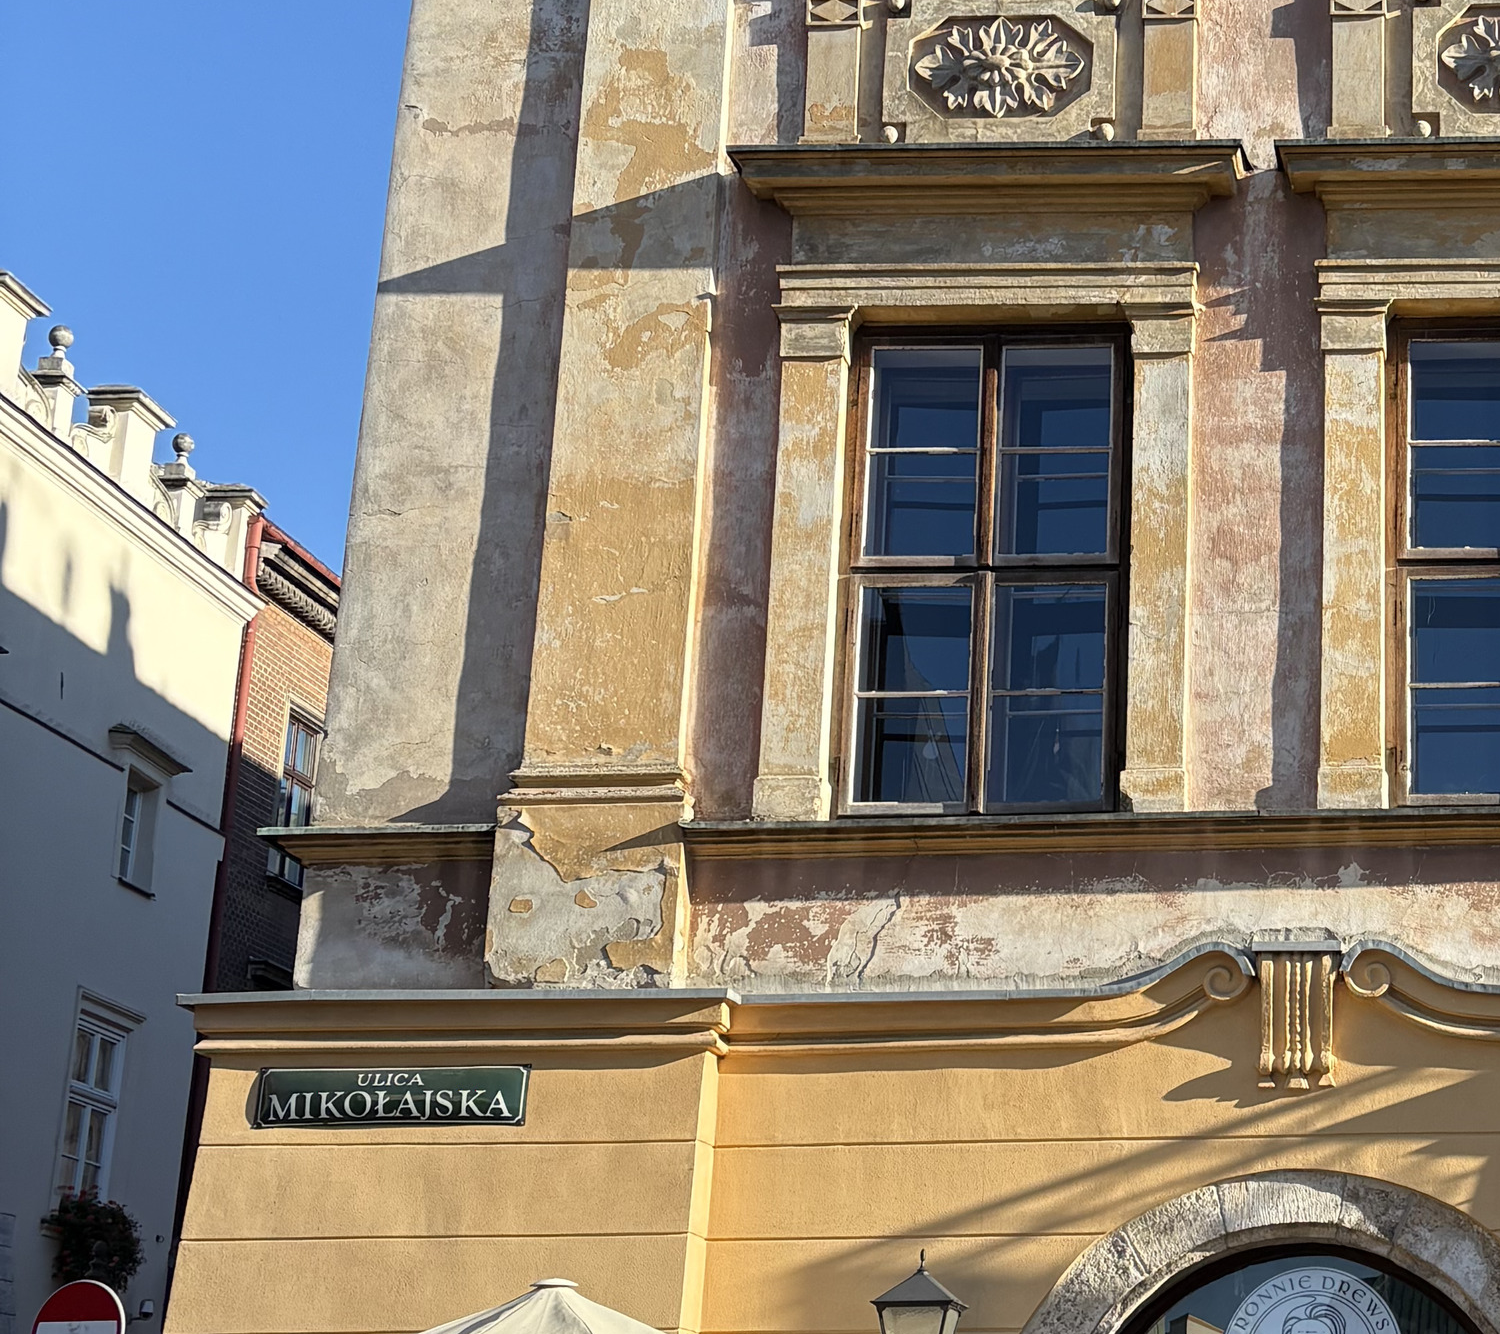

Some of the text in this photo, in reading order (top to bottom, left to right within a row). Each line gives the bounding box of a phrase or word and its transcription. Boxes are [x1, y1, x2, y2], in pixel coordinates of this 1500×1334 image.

[357, 1073, 425, 1087] ULICA
[267, 1089, 513, 1121] MIKOŁAJSKA
[1234, 1275, 1390, 1331] RONNIE DREWS
